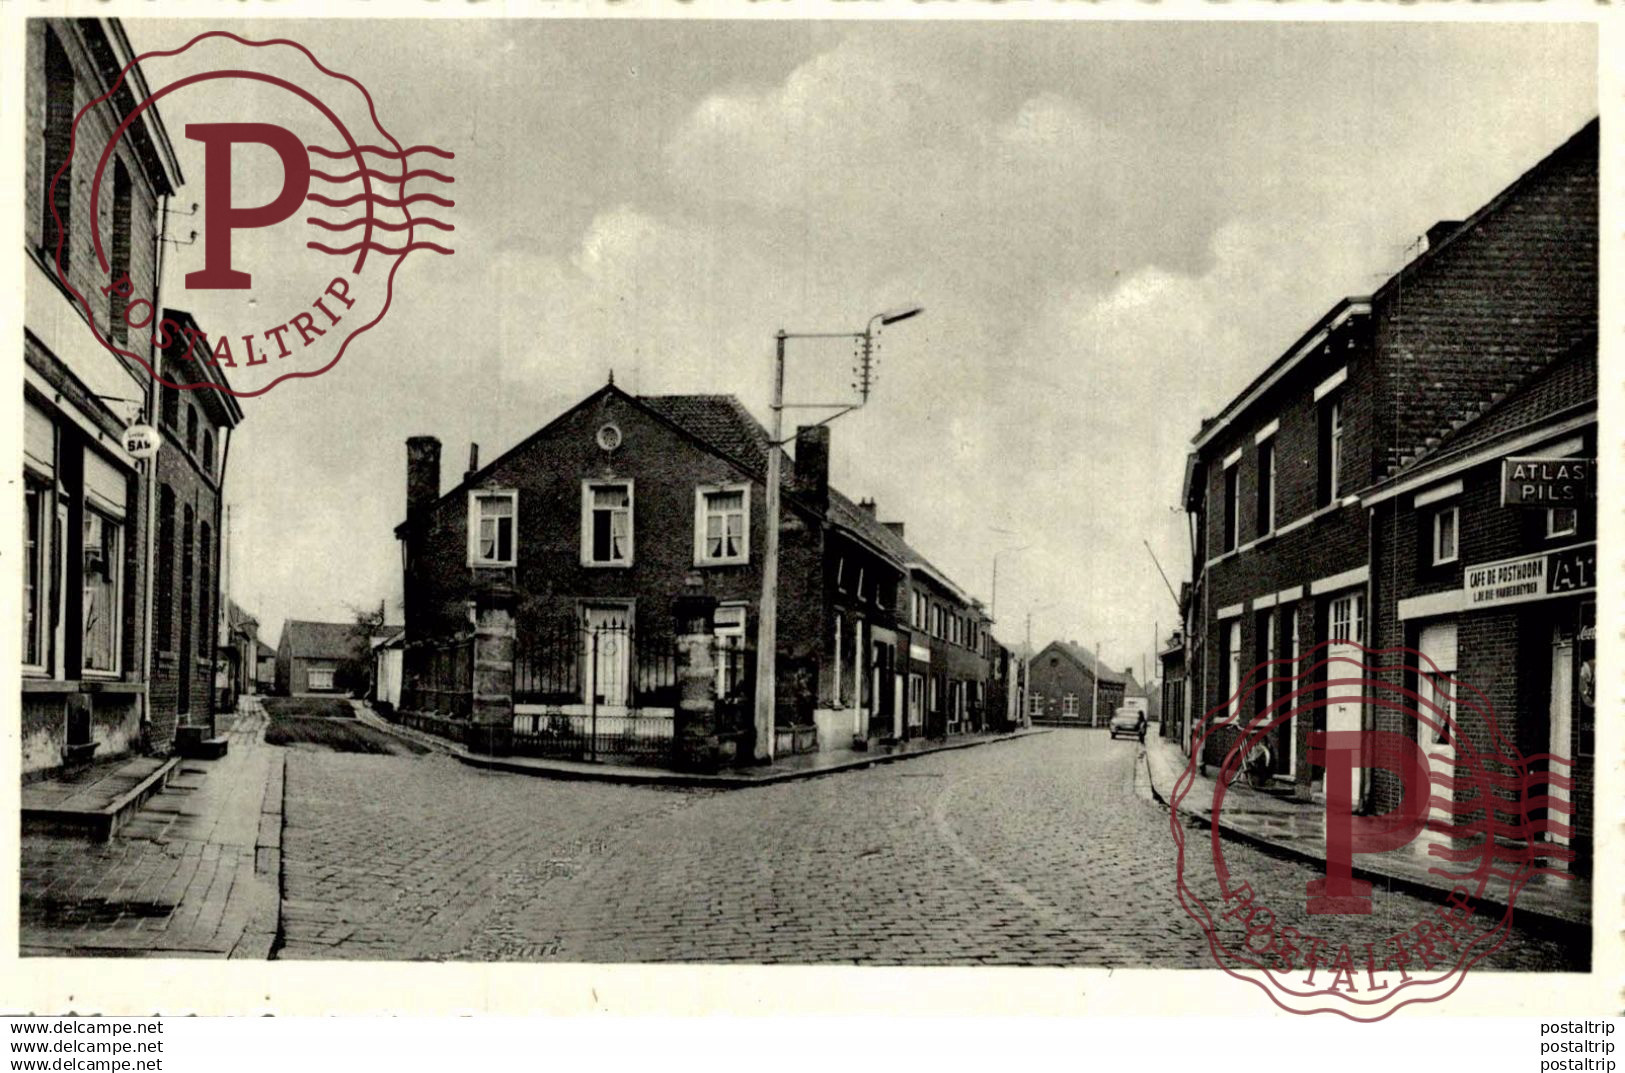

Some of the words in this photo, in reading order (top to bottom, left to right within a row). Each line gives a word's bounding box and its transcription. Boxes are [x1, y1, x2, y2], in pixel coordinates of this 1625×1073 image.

[1513, 464, 1585, 480] ATLAS
[1522, 485, 1574, 500] PILS
[1470, 571, 1486, 588] CAFE
[1487, 568, 1496, 585] DE
[1498, 560, 1543, 583] POSTHOORN
